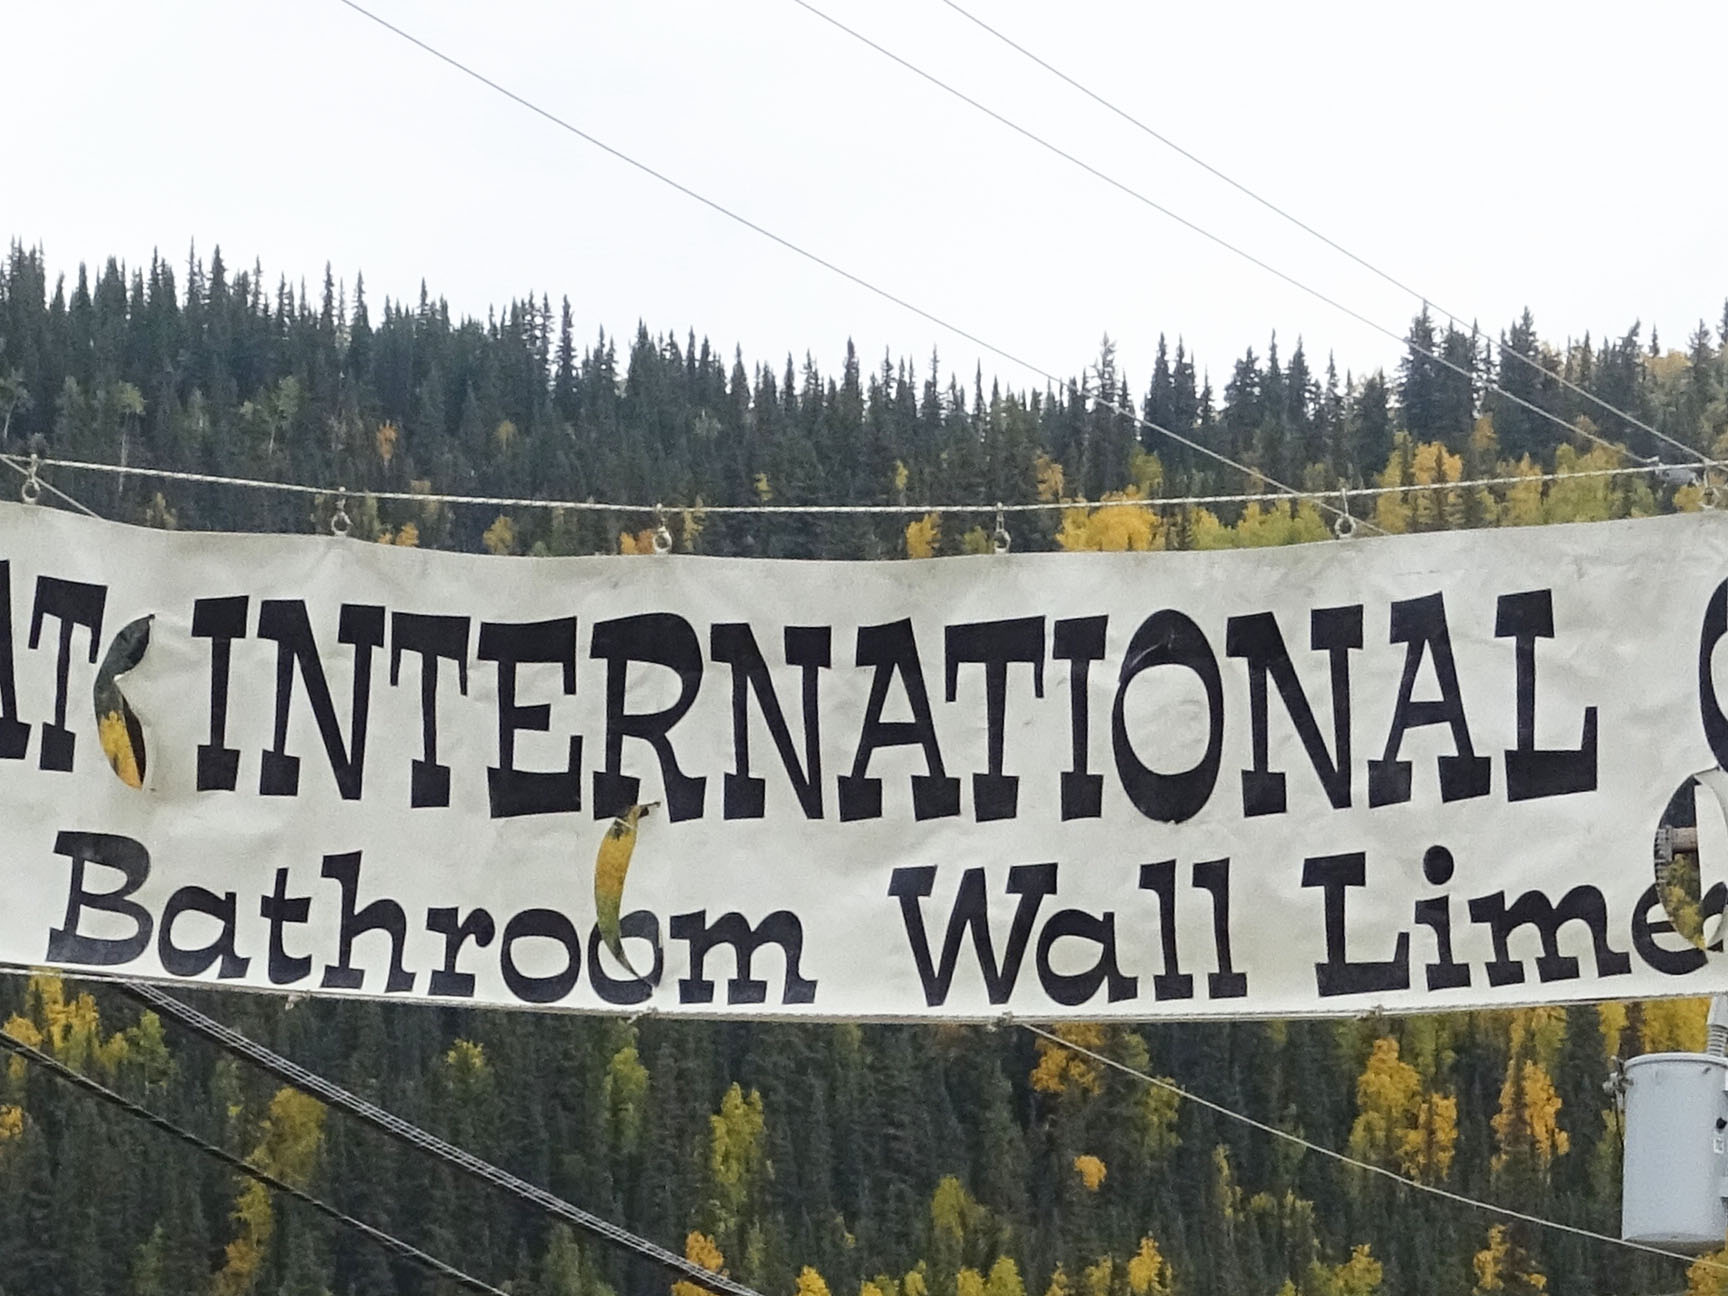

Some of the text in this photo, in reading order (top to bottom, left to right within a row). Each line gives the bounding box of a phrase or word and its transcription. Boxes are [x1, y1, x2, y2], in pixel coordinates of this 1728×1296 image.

[192, 588, 1598, 824] INTERNATIONAL
[45, 830, 818, 1005] Bathroom
[887, 857, 1248, 1007] Wall
